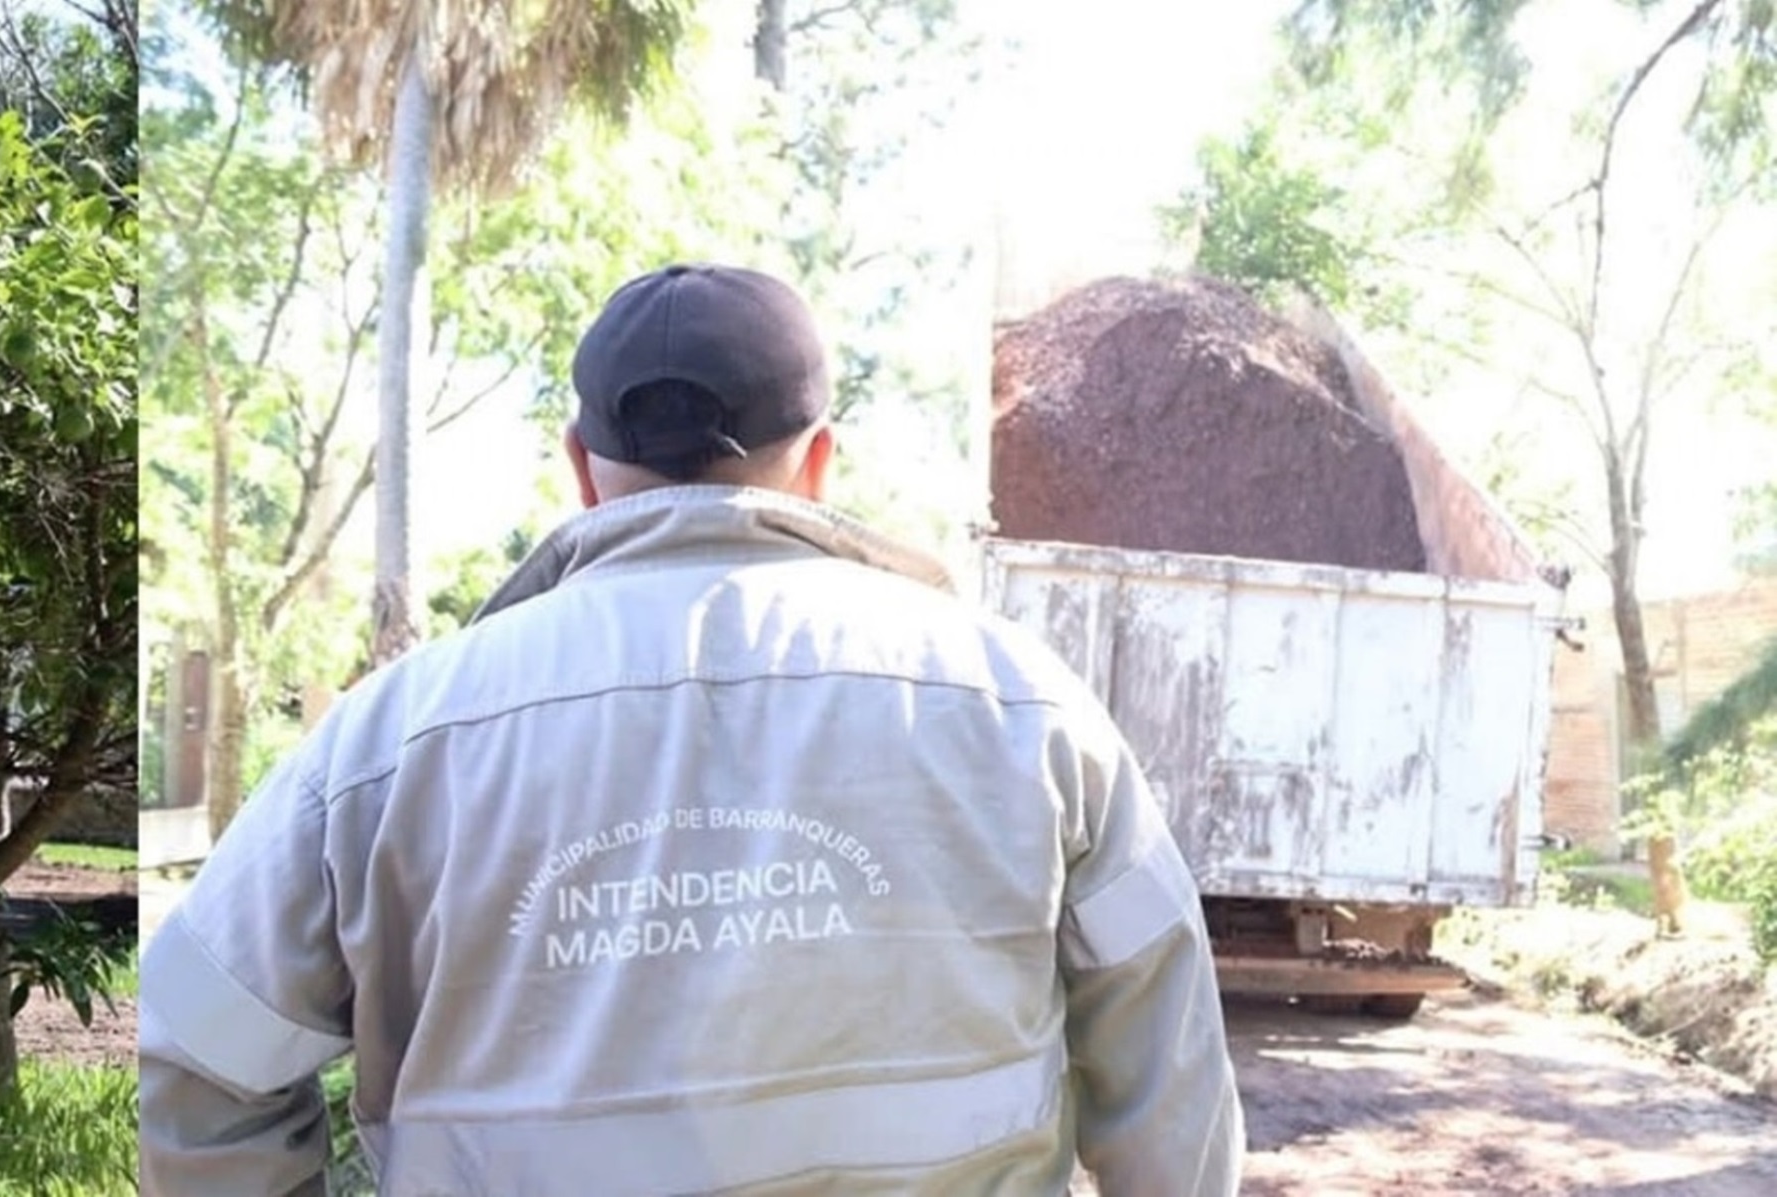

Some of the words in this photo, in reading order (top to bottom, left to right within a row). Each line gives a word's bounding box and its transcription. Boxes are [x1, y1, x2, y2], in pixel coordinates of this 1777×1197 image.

[508, 811, 670, 937] MUNICIPALIDAD
[675, 808, 704, 829] DE
[709, 807, 890, 896] BARRANQUERAS
[557, 859, 838, 922] INTENDENCIA
[546, 917, 702, 968] MAGDA
[713, 903, 853, 951] AYALA
